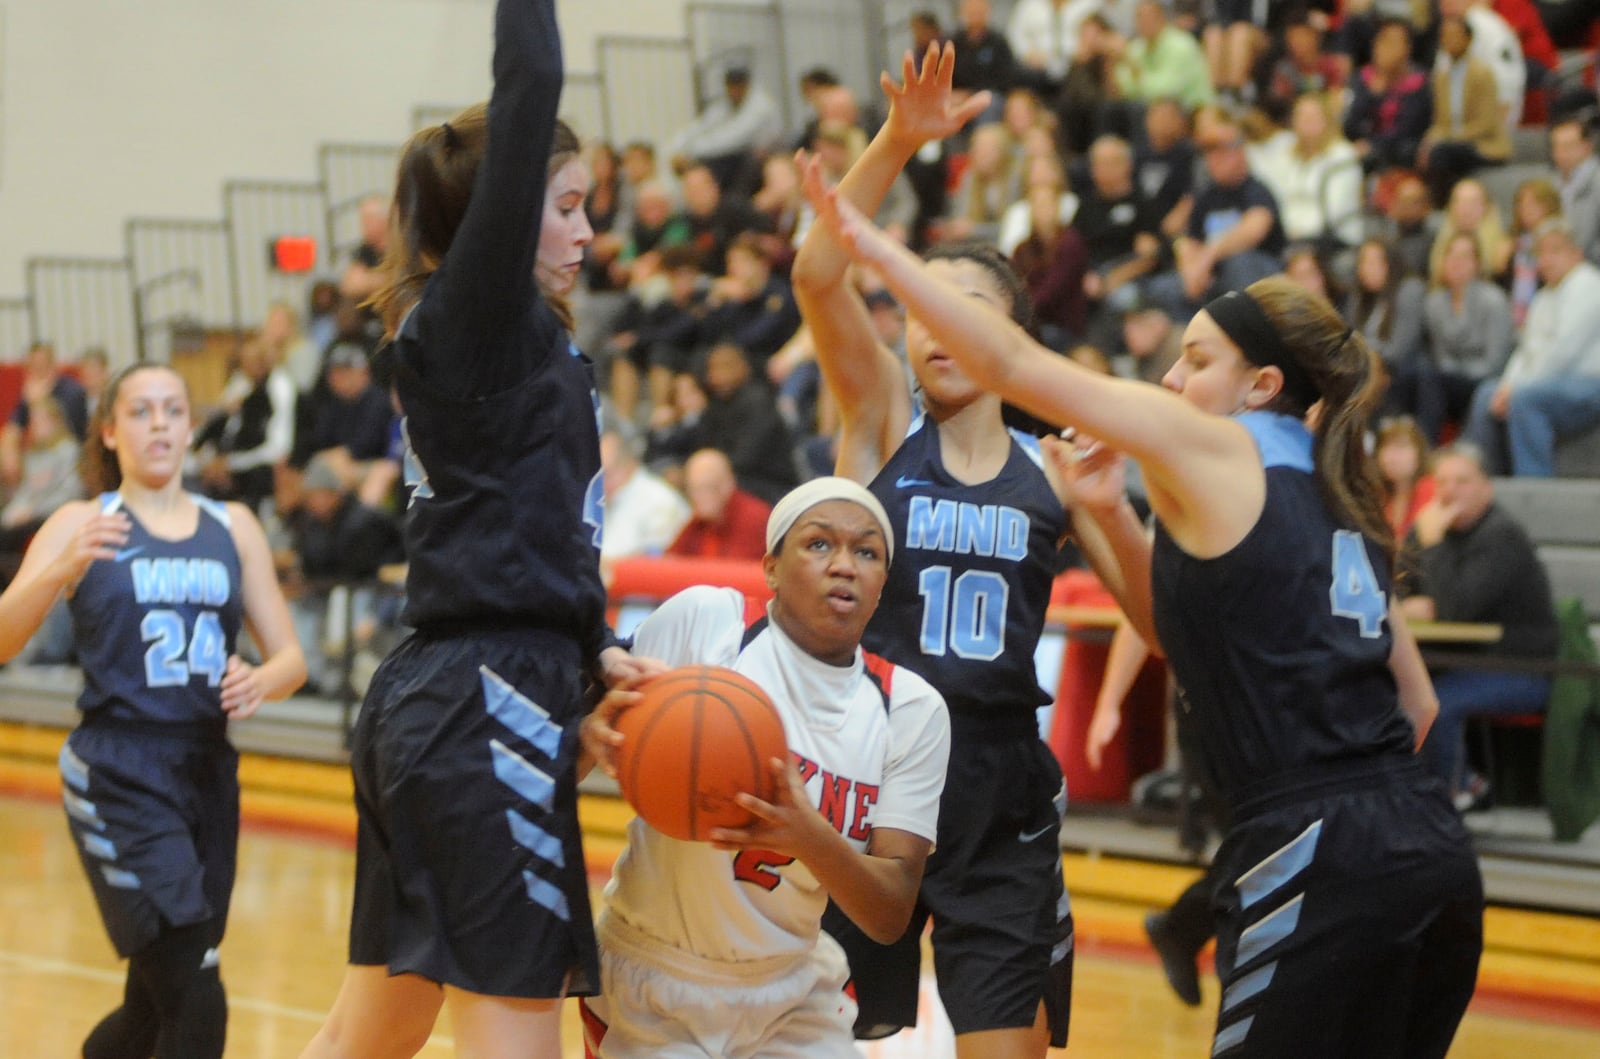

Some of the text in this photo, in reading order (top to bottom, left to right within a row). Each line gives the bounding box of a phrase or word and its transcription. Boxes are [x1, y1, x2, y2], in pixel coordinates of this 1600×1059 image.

[905, 495, 1031, 562] MND
[130, 557, 231, 607] MND
[918, 564, 1010, 662] 10
[1329, 528, 1387, 639] 4
[140, 608, 228, 688] 24
